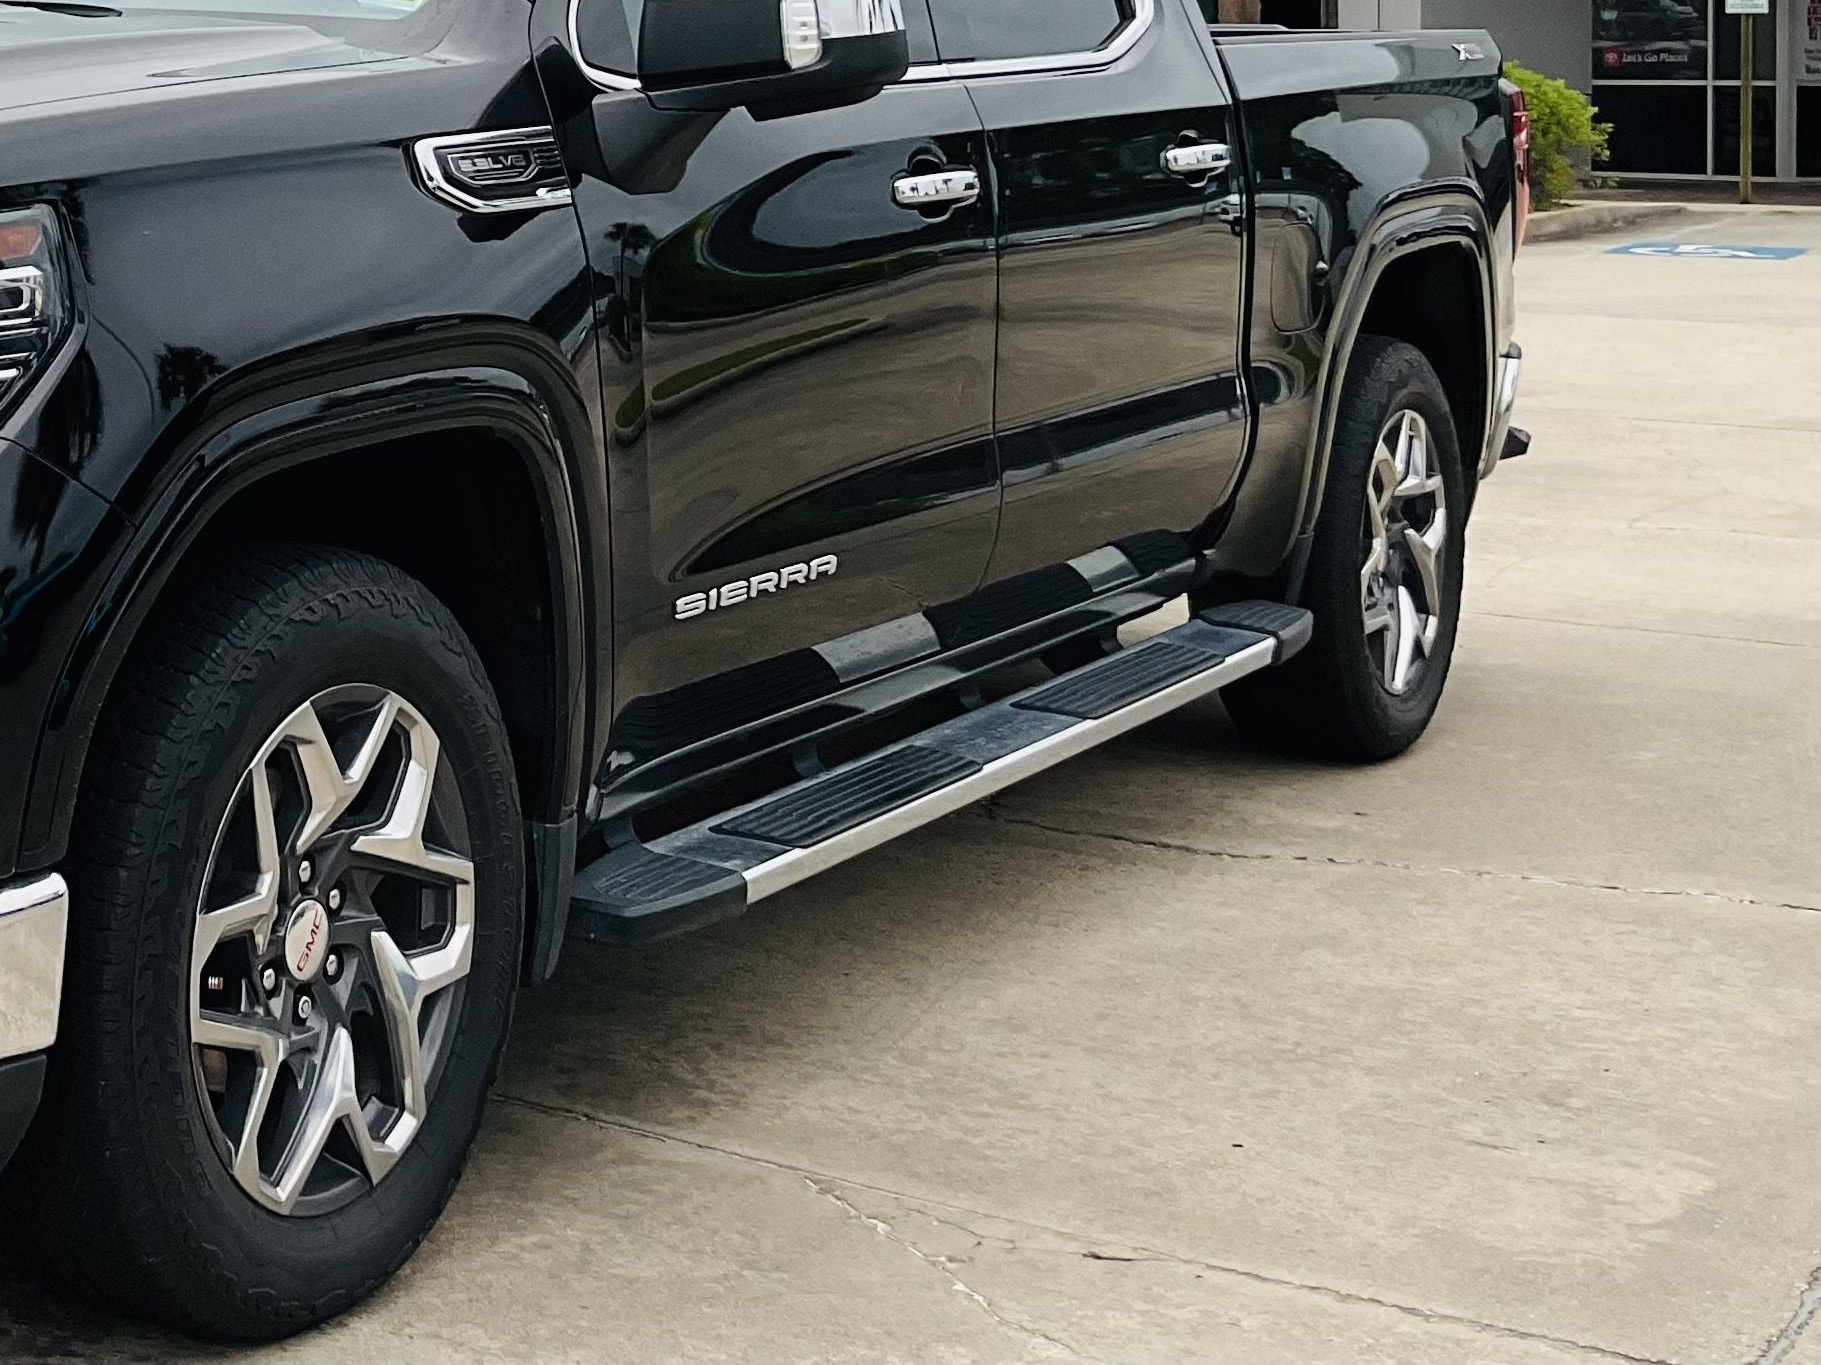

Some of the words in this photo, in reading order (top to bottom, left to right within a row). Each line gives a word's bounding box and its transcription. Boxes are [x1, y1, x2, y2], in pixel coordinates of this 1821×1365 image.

[1644, 52, 1658, 63] Go
[674, 553, 839, 621] SIERRA
[296, 908, 323, 972] GMC
